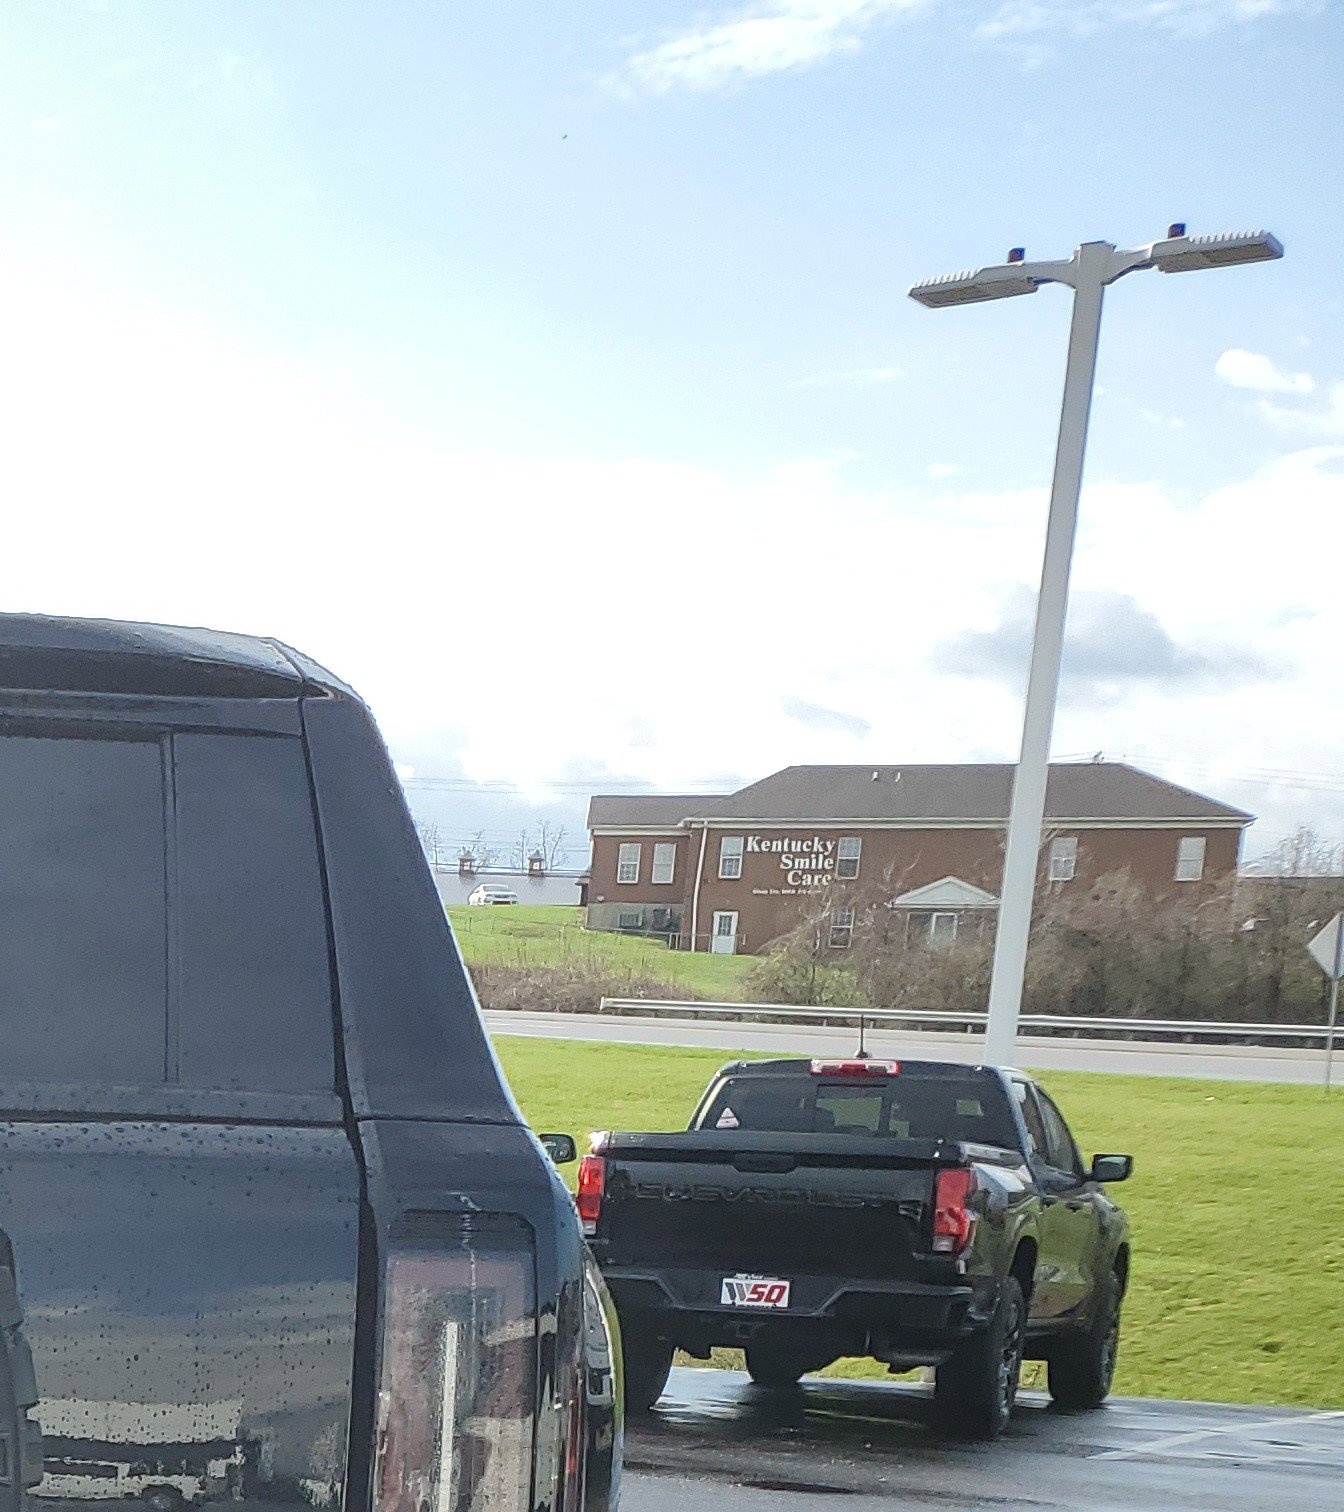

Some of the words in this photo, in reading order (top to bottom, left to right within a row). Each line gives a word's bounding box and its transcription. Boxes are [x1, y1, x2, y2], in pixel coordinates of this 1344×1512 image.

[746, 836, 836, 855] Kentucky
[780, 854, 834, 869] Smile
[787, 870, 832, 886] Care
